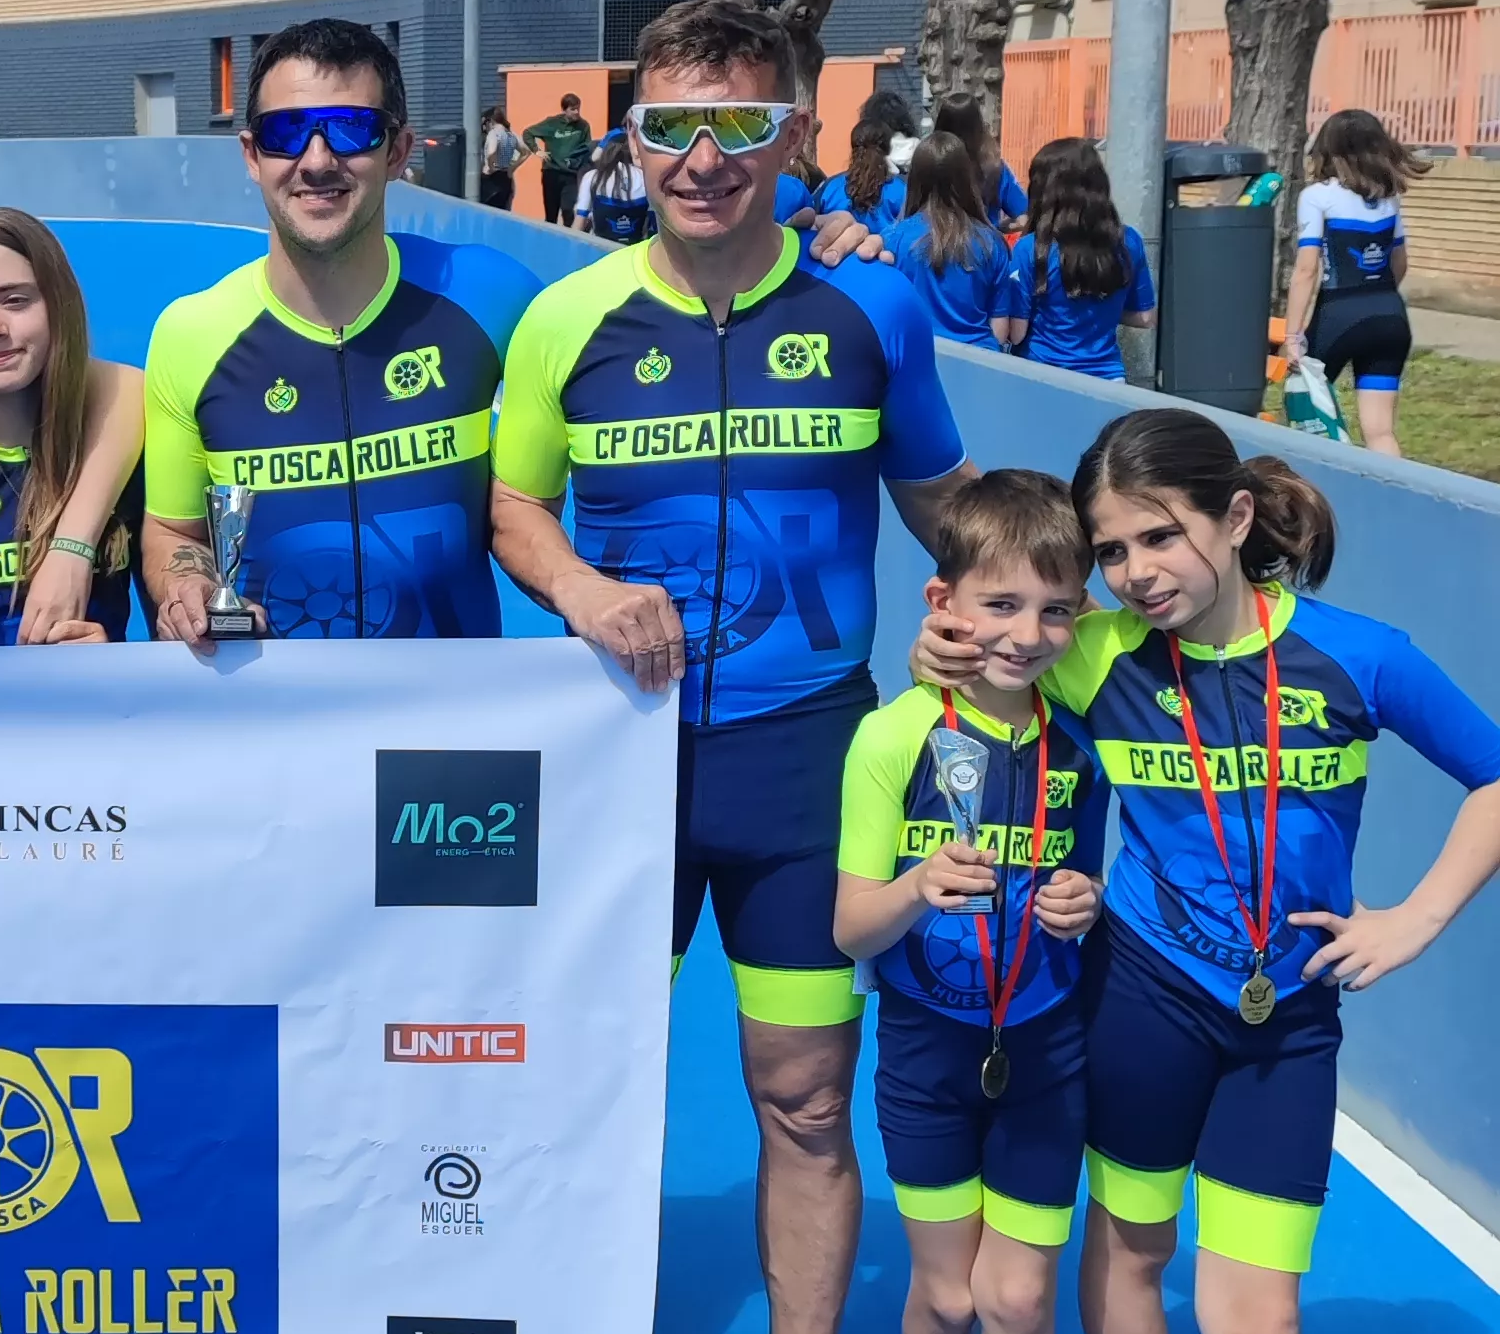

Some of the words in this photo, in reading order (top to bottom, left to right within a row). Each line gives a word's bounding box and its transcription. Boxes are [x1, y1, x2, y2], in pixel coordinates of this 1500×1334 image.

[595, 427, 627, 460] CP
[632, 418, 716, 458] OSCA
[729, 414, 843, 448] ROLLER
[234, 455, 263, 486] CP
[269, 447, 344, 485] OSCA
[356, 424, 458, 475] ROLLER
[1129, 747, 1155, 781] CP
[907, 824, 936, 854] CP
[392, 1030, 517, 1057] UNITIC
[421, 1201, 485, 1225] MIGUEL
[421, 1224, 484, 1236] ESCUER
[24, 1268, 238, 1334] ROLLER
